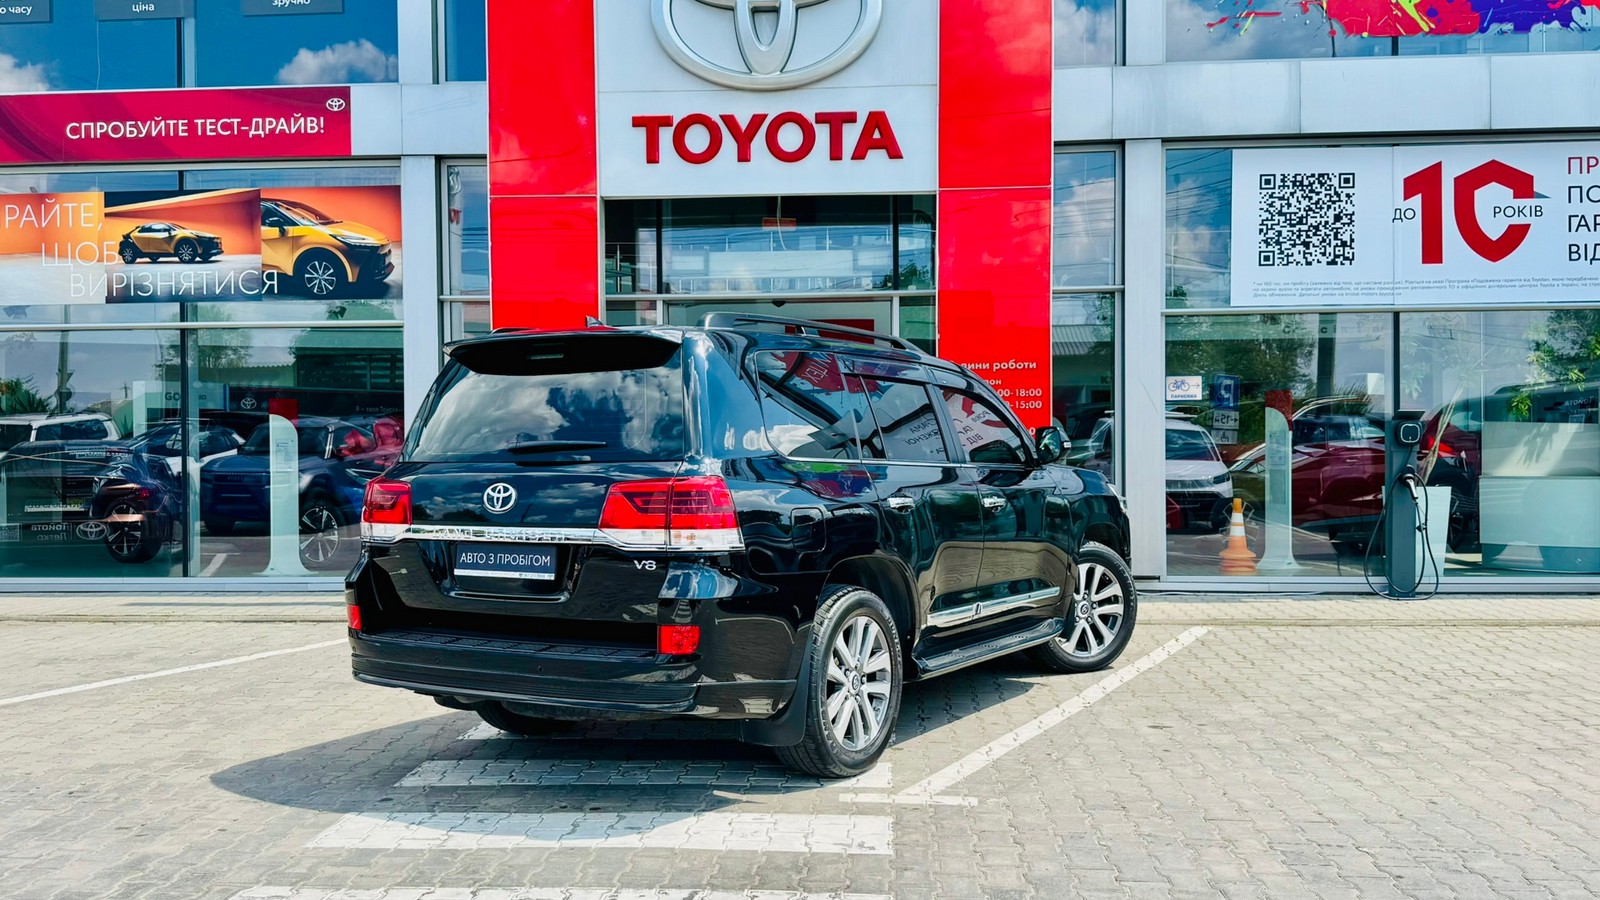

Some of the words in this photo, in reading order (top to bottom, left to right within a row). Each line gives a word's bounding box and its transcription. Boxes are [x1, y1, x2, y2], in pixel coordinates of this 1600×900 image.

[9, 5, 33, 15] часу
[132, 3, 155, 12] ціна
[66, 116, 188, 139] СПРОБУЙТЕ
[194, 113, 325, 138] ТЕСТ-ДРАЙВ!
[632, 110, 904, 164] TOYOTA
[5, 198, 103, 231] РАЙТЕ,
[1392, 208, 1416, 223] ДО
[1493, 205, 1544, 218] РОКІВ
[41, 241, 119, 271] ЩОБ
[70, 269, 279, 298] ВИРІЗНЯТИСЯ
[993, 359, 1037, 372] роботи
[460, 552, 486, 565] АВТО
[488, 553, 495, 565] З
[497, 554, 551, 567] ПРОБІГОМ
[633, 560, 657, 571] V8
